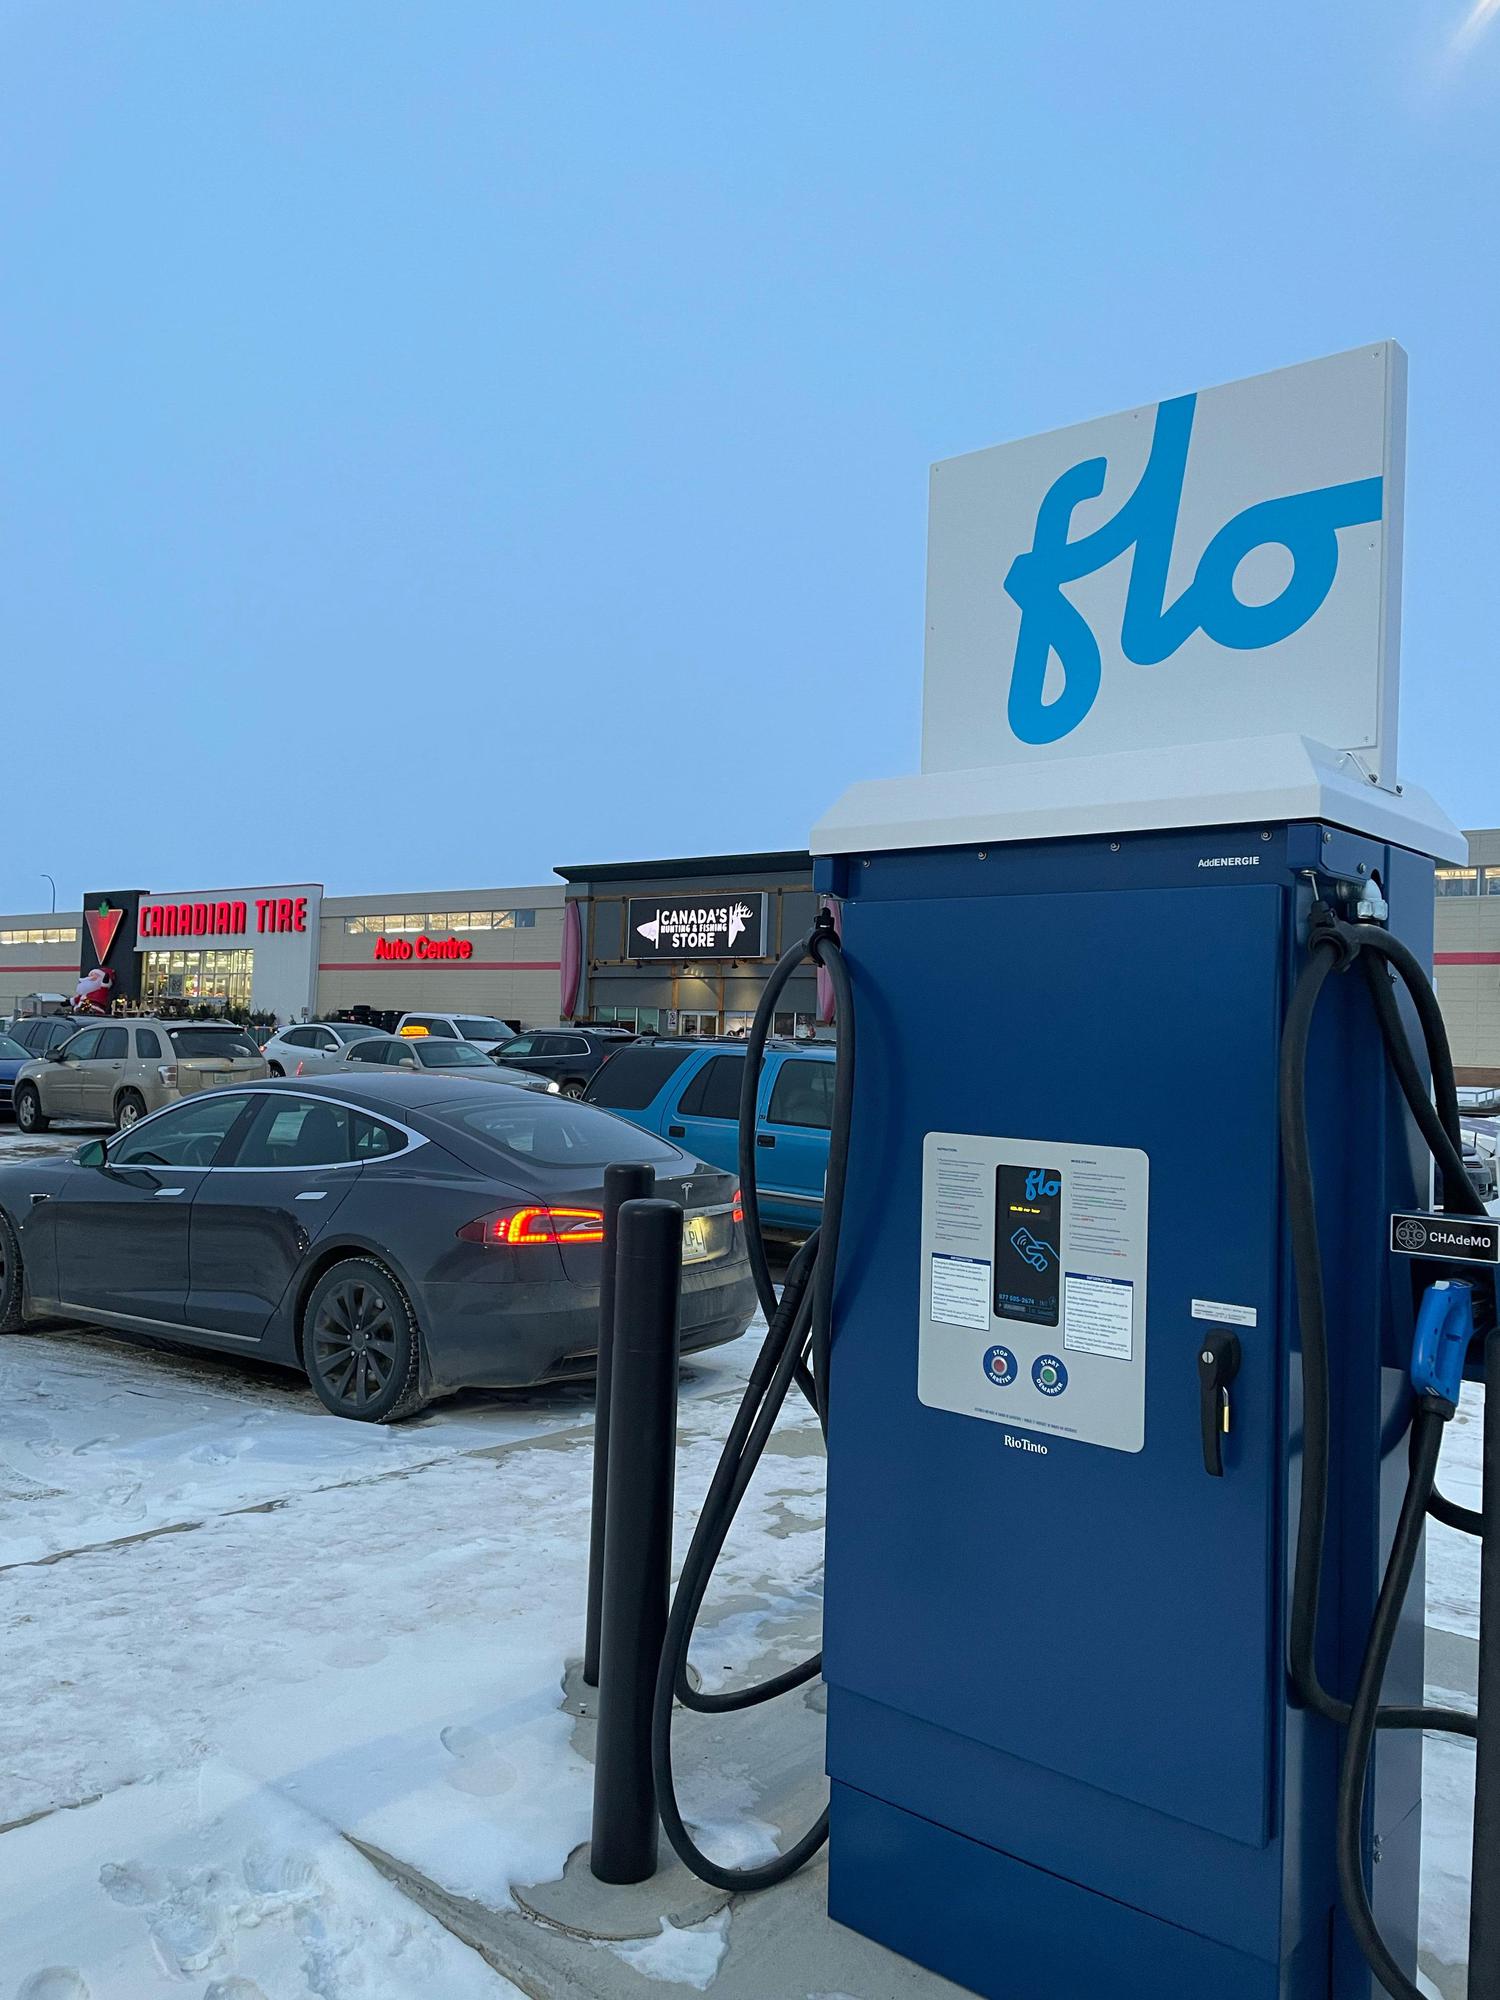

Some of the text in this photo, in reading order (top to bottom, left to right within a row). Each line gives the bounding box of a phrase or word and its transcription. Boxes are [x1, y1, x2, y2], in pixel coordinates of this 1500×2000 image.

[1003, 392, 1383, 745] flo
[139, 897, 307, 937] CANADIAN TIRE
[660, 908, 728, 925] CANADA'S
[660, 923, 728, 934] HUNTING & FISHING
[373, 935, 473, 960] Auto Centre
[672, 933, 715, 948] STORE
[1025, 1169, 1061, 1201] flo
[1429, 1232, 1491, 1248] CHAdeMO
[993, 1349, 1008, 1357] STOP
[1040, 1359, 1060, 1368] START
